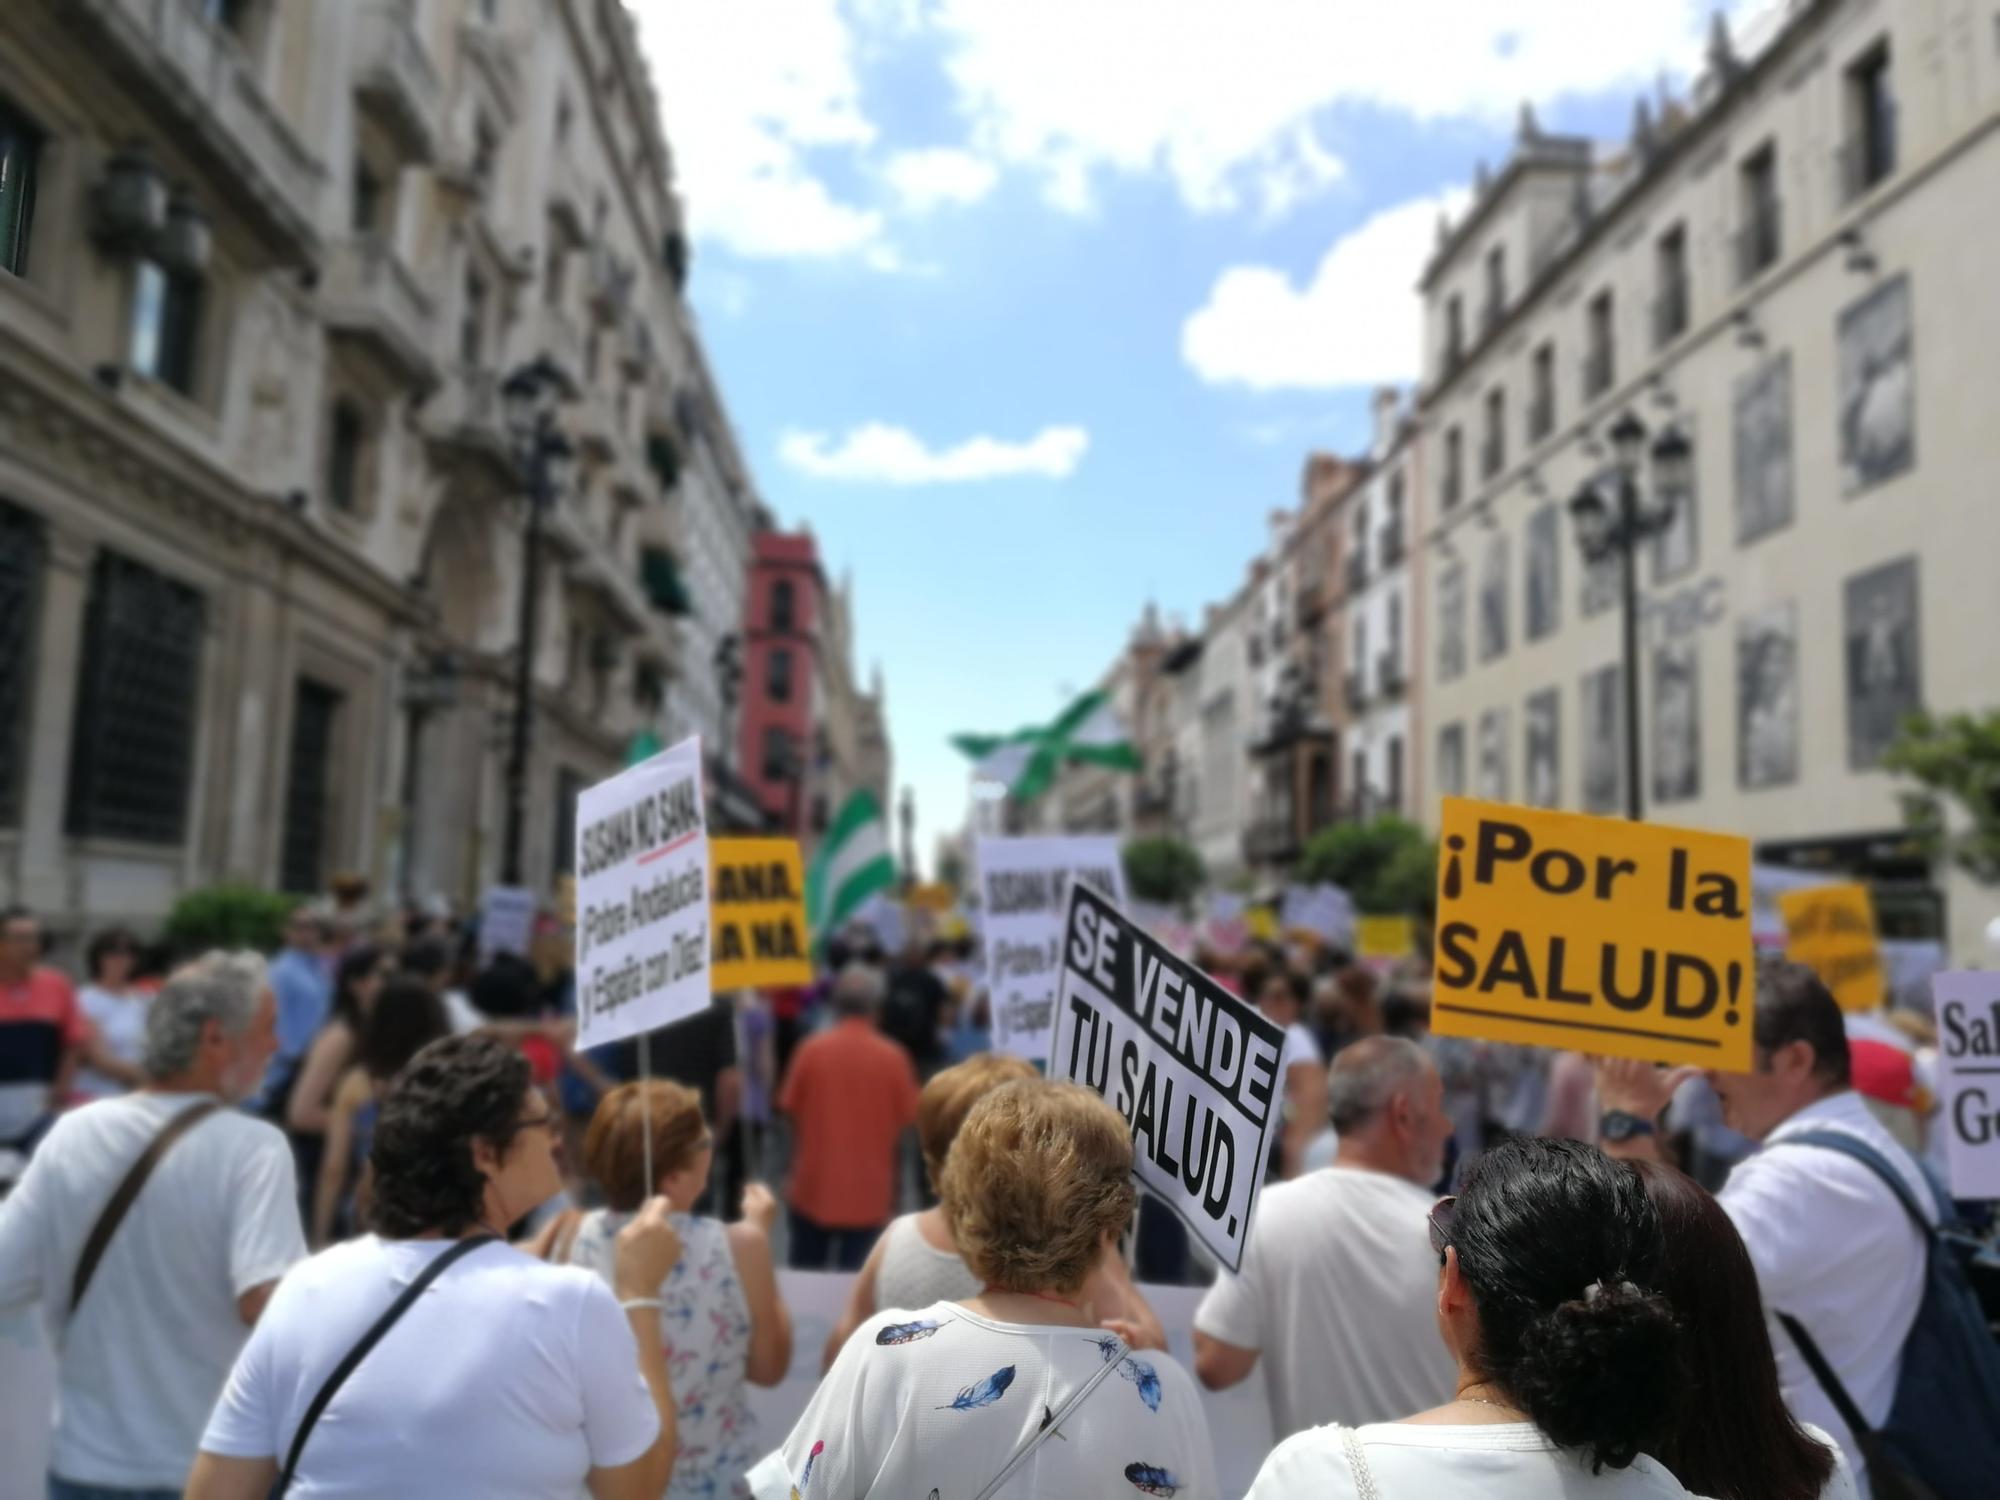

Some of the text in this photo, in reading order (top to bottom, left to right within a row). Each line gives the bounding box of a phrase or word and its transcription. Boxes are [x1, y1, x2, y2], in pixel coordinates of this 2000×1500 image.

[1443, 819, 1744, 919] ¡Por la
[1071, 902, 1278, 1120] SE VENDE
[1437, 921, 1742, 1027] SALUD!
[1070, 994, 1113, 1093] TU
[1117, 1040, 1238, 1239] SALUD.
[1953, 1086, 2000, 1146] G
